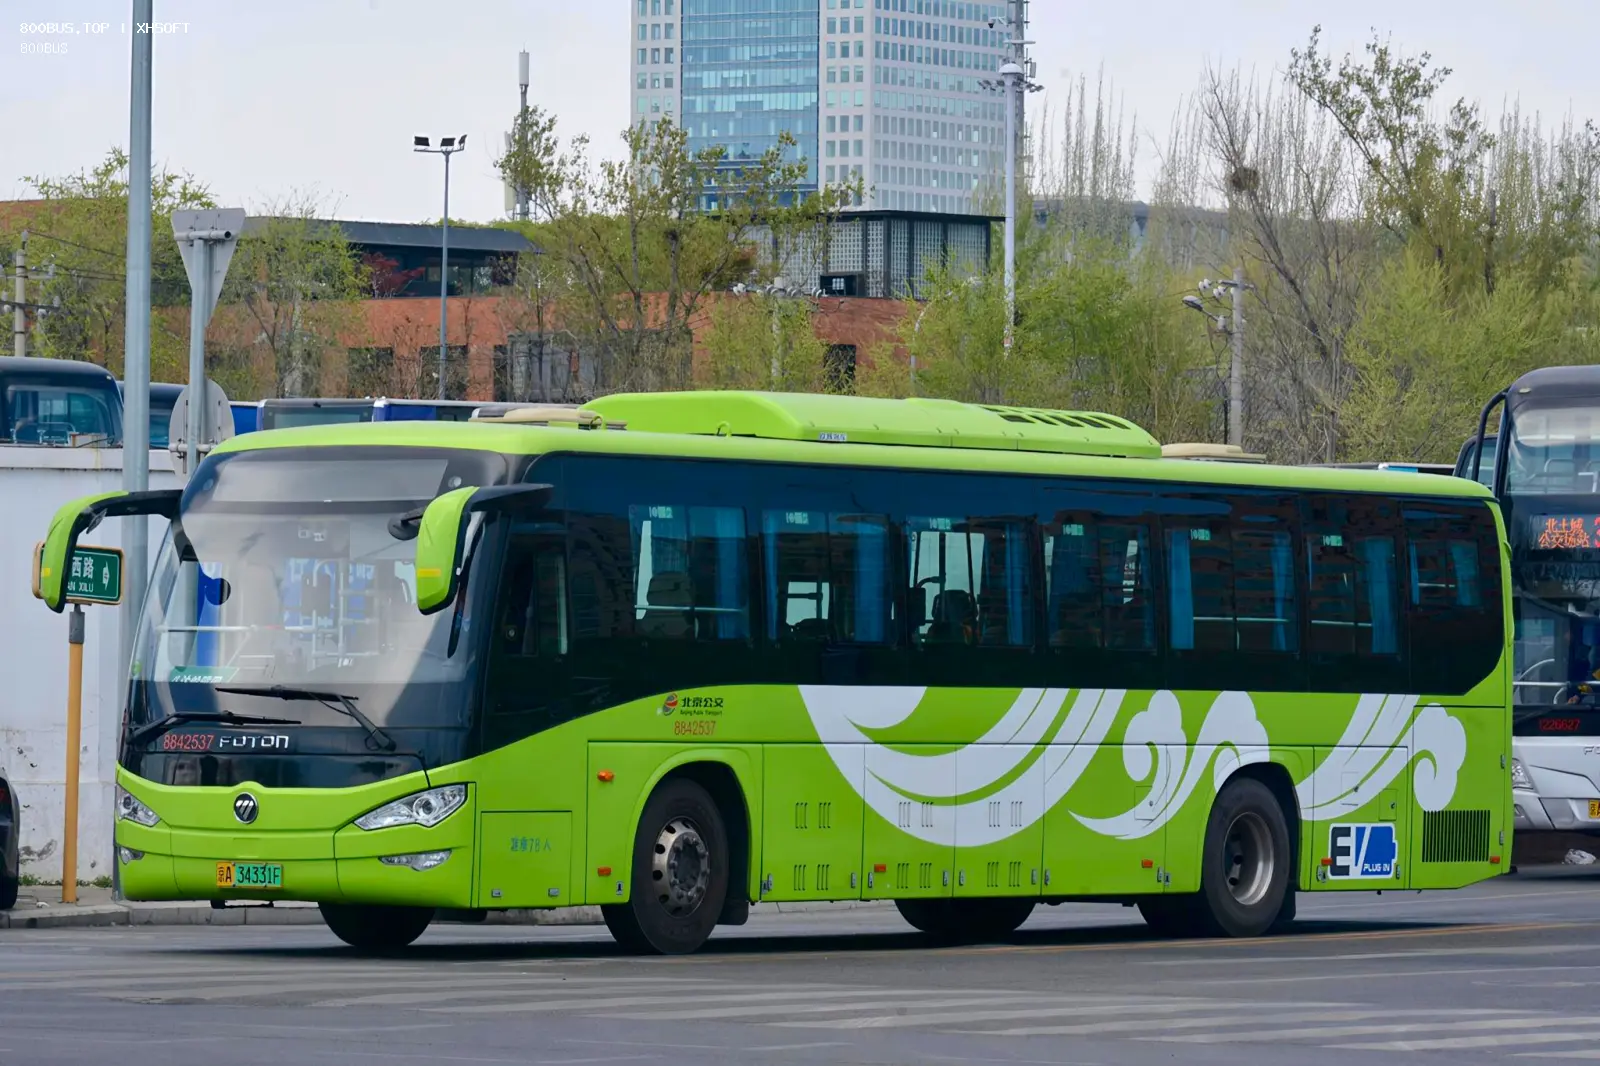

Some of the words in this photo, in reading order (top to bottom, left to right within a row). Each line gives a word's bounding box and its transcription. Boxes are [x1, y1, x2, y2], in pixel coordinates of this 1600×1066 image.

[71, 556, 94, 579] 西路
[681, 697, 724, 708] 北京公交
[674, 720, 716, 736] 8842537
[163, 734, 215, 750] 8842537
[219, 735, 289, 749] FOTON
[1363, 864, 1381, 872] PLUG
[1382, 864, 1390, 872] IN
